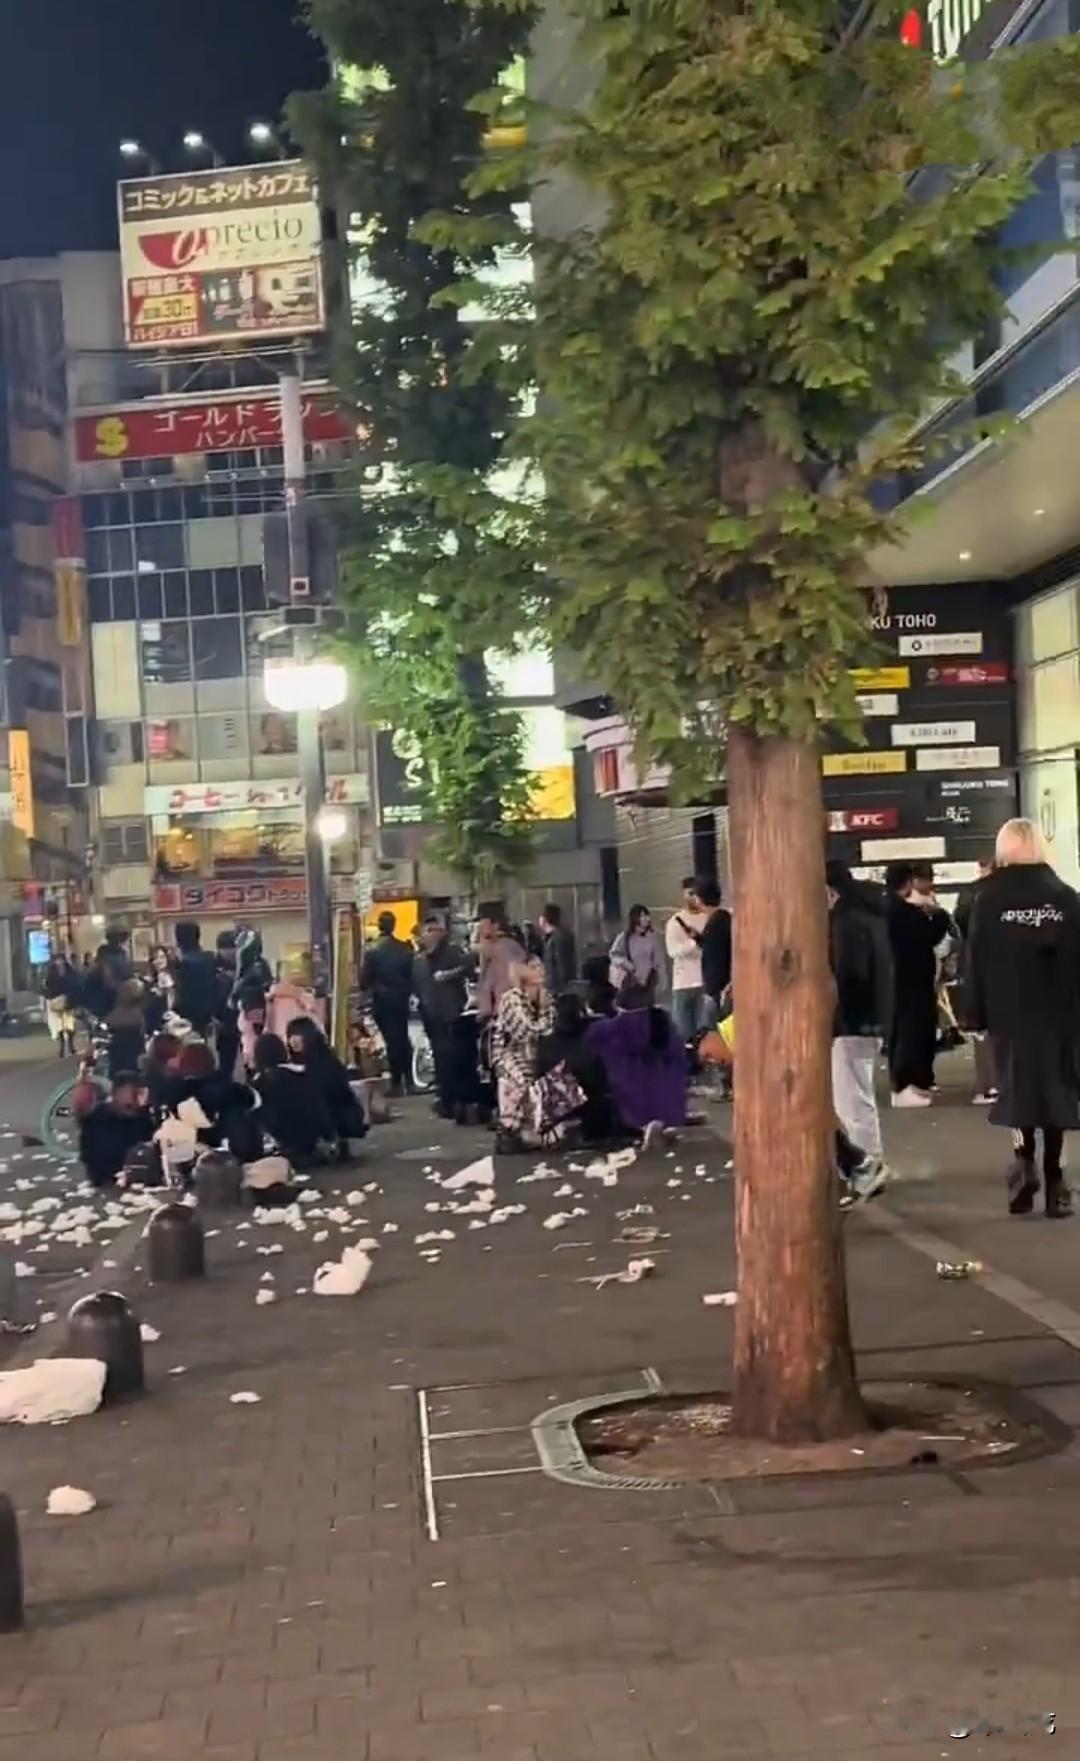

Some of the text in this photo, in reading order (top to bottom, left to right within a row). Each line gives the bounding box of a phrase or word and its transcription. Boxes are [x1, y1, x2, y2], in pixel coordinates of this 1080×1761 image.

[195, 425, 287, 448] ハンバー
[896, 613, 937, 628] TOHO
[850, 813, 885, 827] KFC
